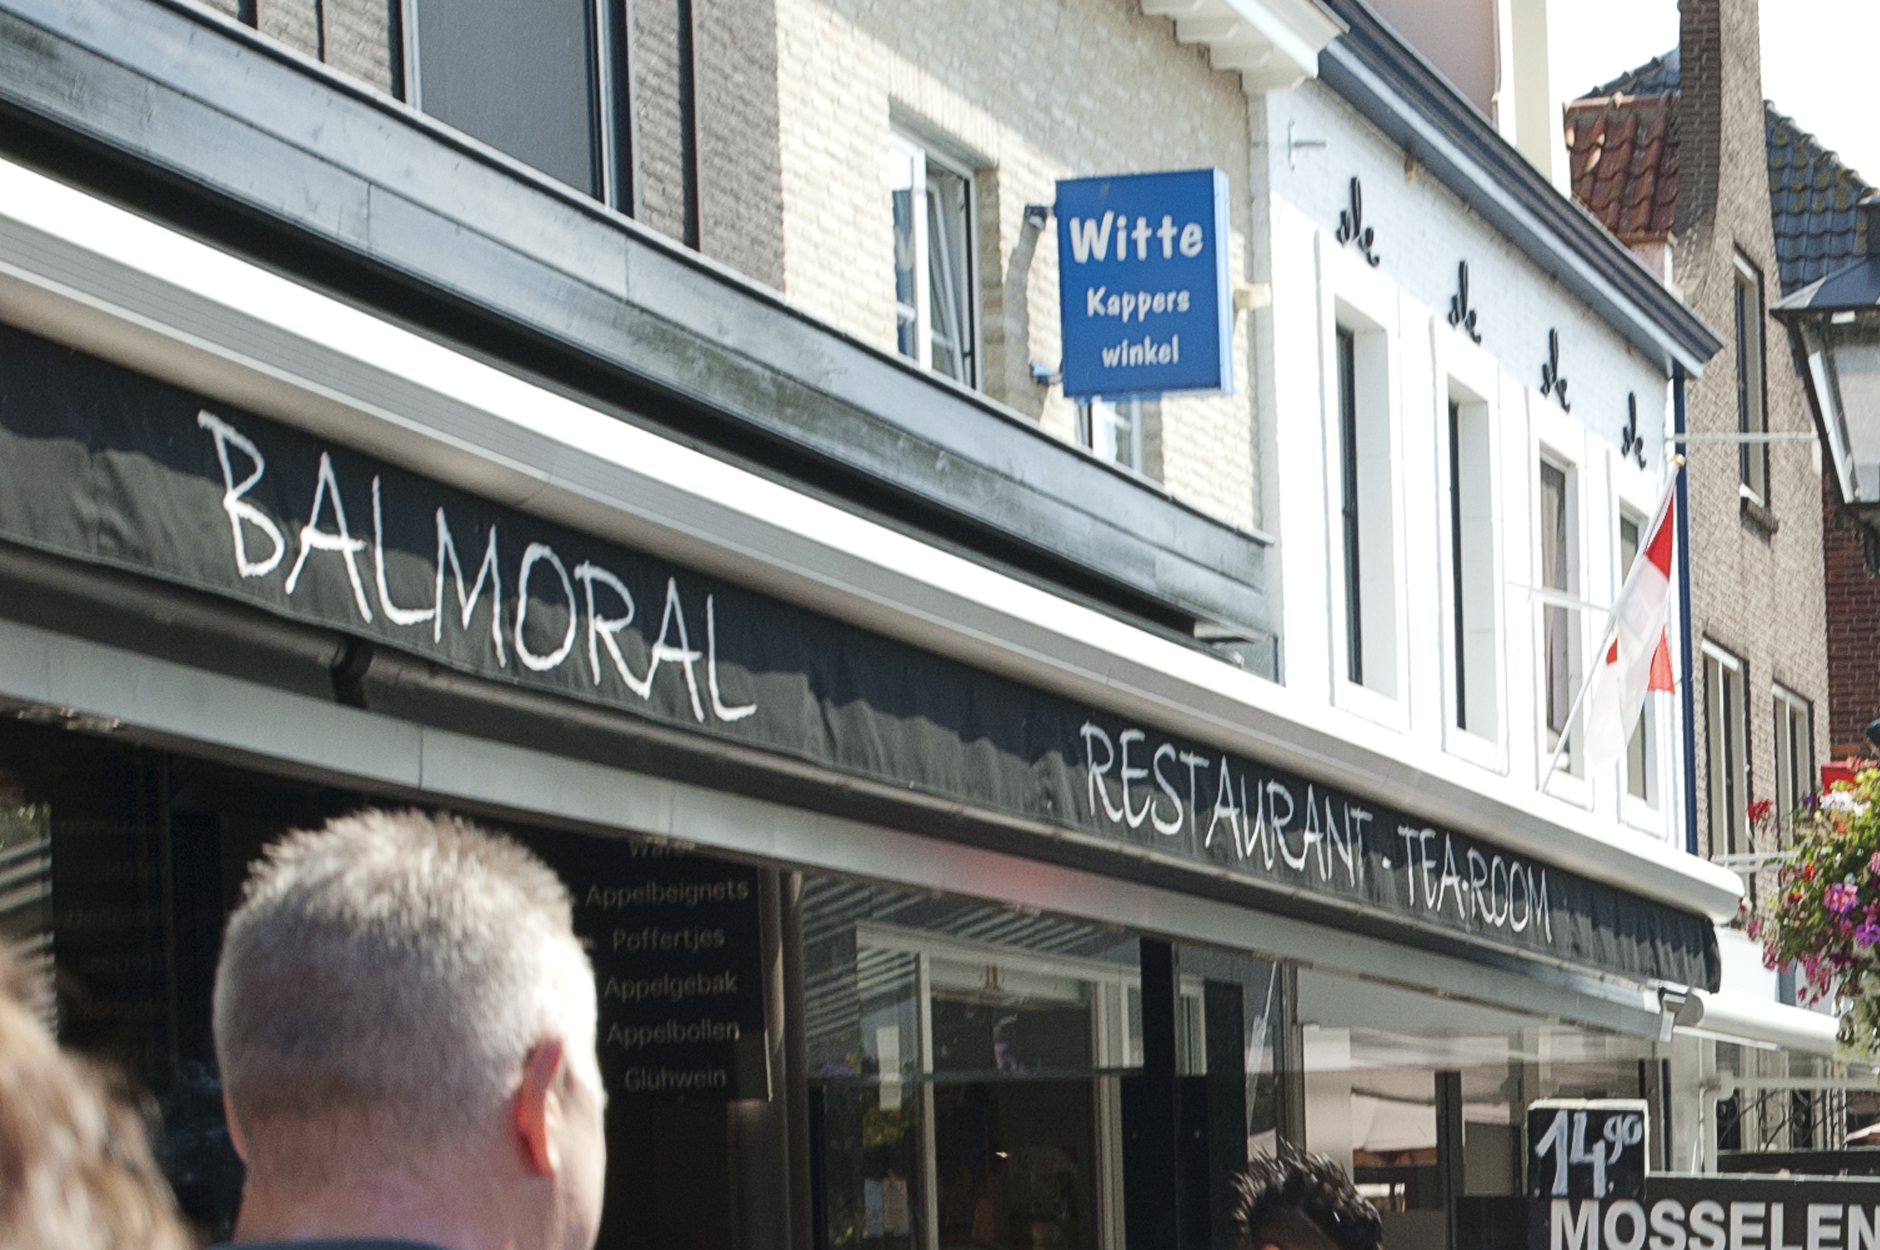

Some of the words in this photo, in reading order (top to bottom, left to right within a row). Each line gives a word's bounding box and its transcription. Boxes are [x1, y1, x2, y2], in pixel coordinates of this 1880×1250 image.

[1069, 210, 1203, 264] Witte
[1086, 285, 1190, 323] Kappers
[1102, 334, 1179, 368] winkel
[199, 409, 757, 724] BALMORAL
[1080, 721, 1373, 890] RESTAURANT
[585, 878, 749, 911] Appelbeignets
[612, 926, 726, 957] Poffertjes
[604, 967, 738, 1003] Appelgebak
[606, 1017, 741, 1050] Appelbollen
[624, 1063, 727, 1093] Glühwein
